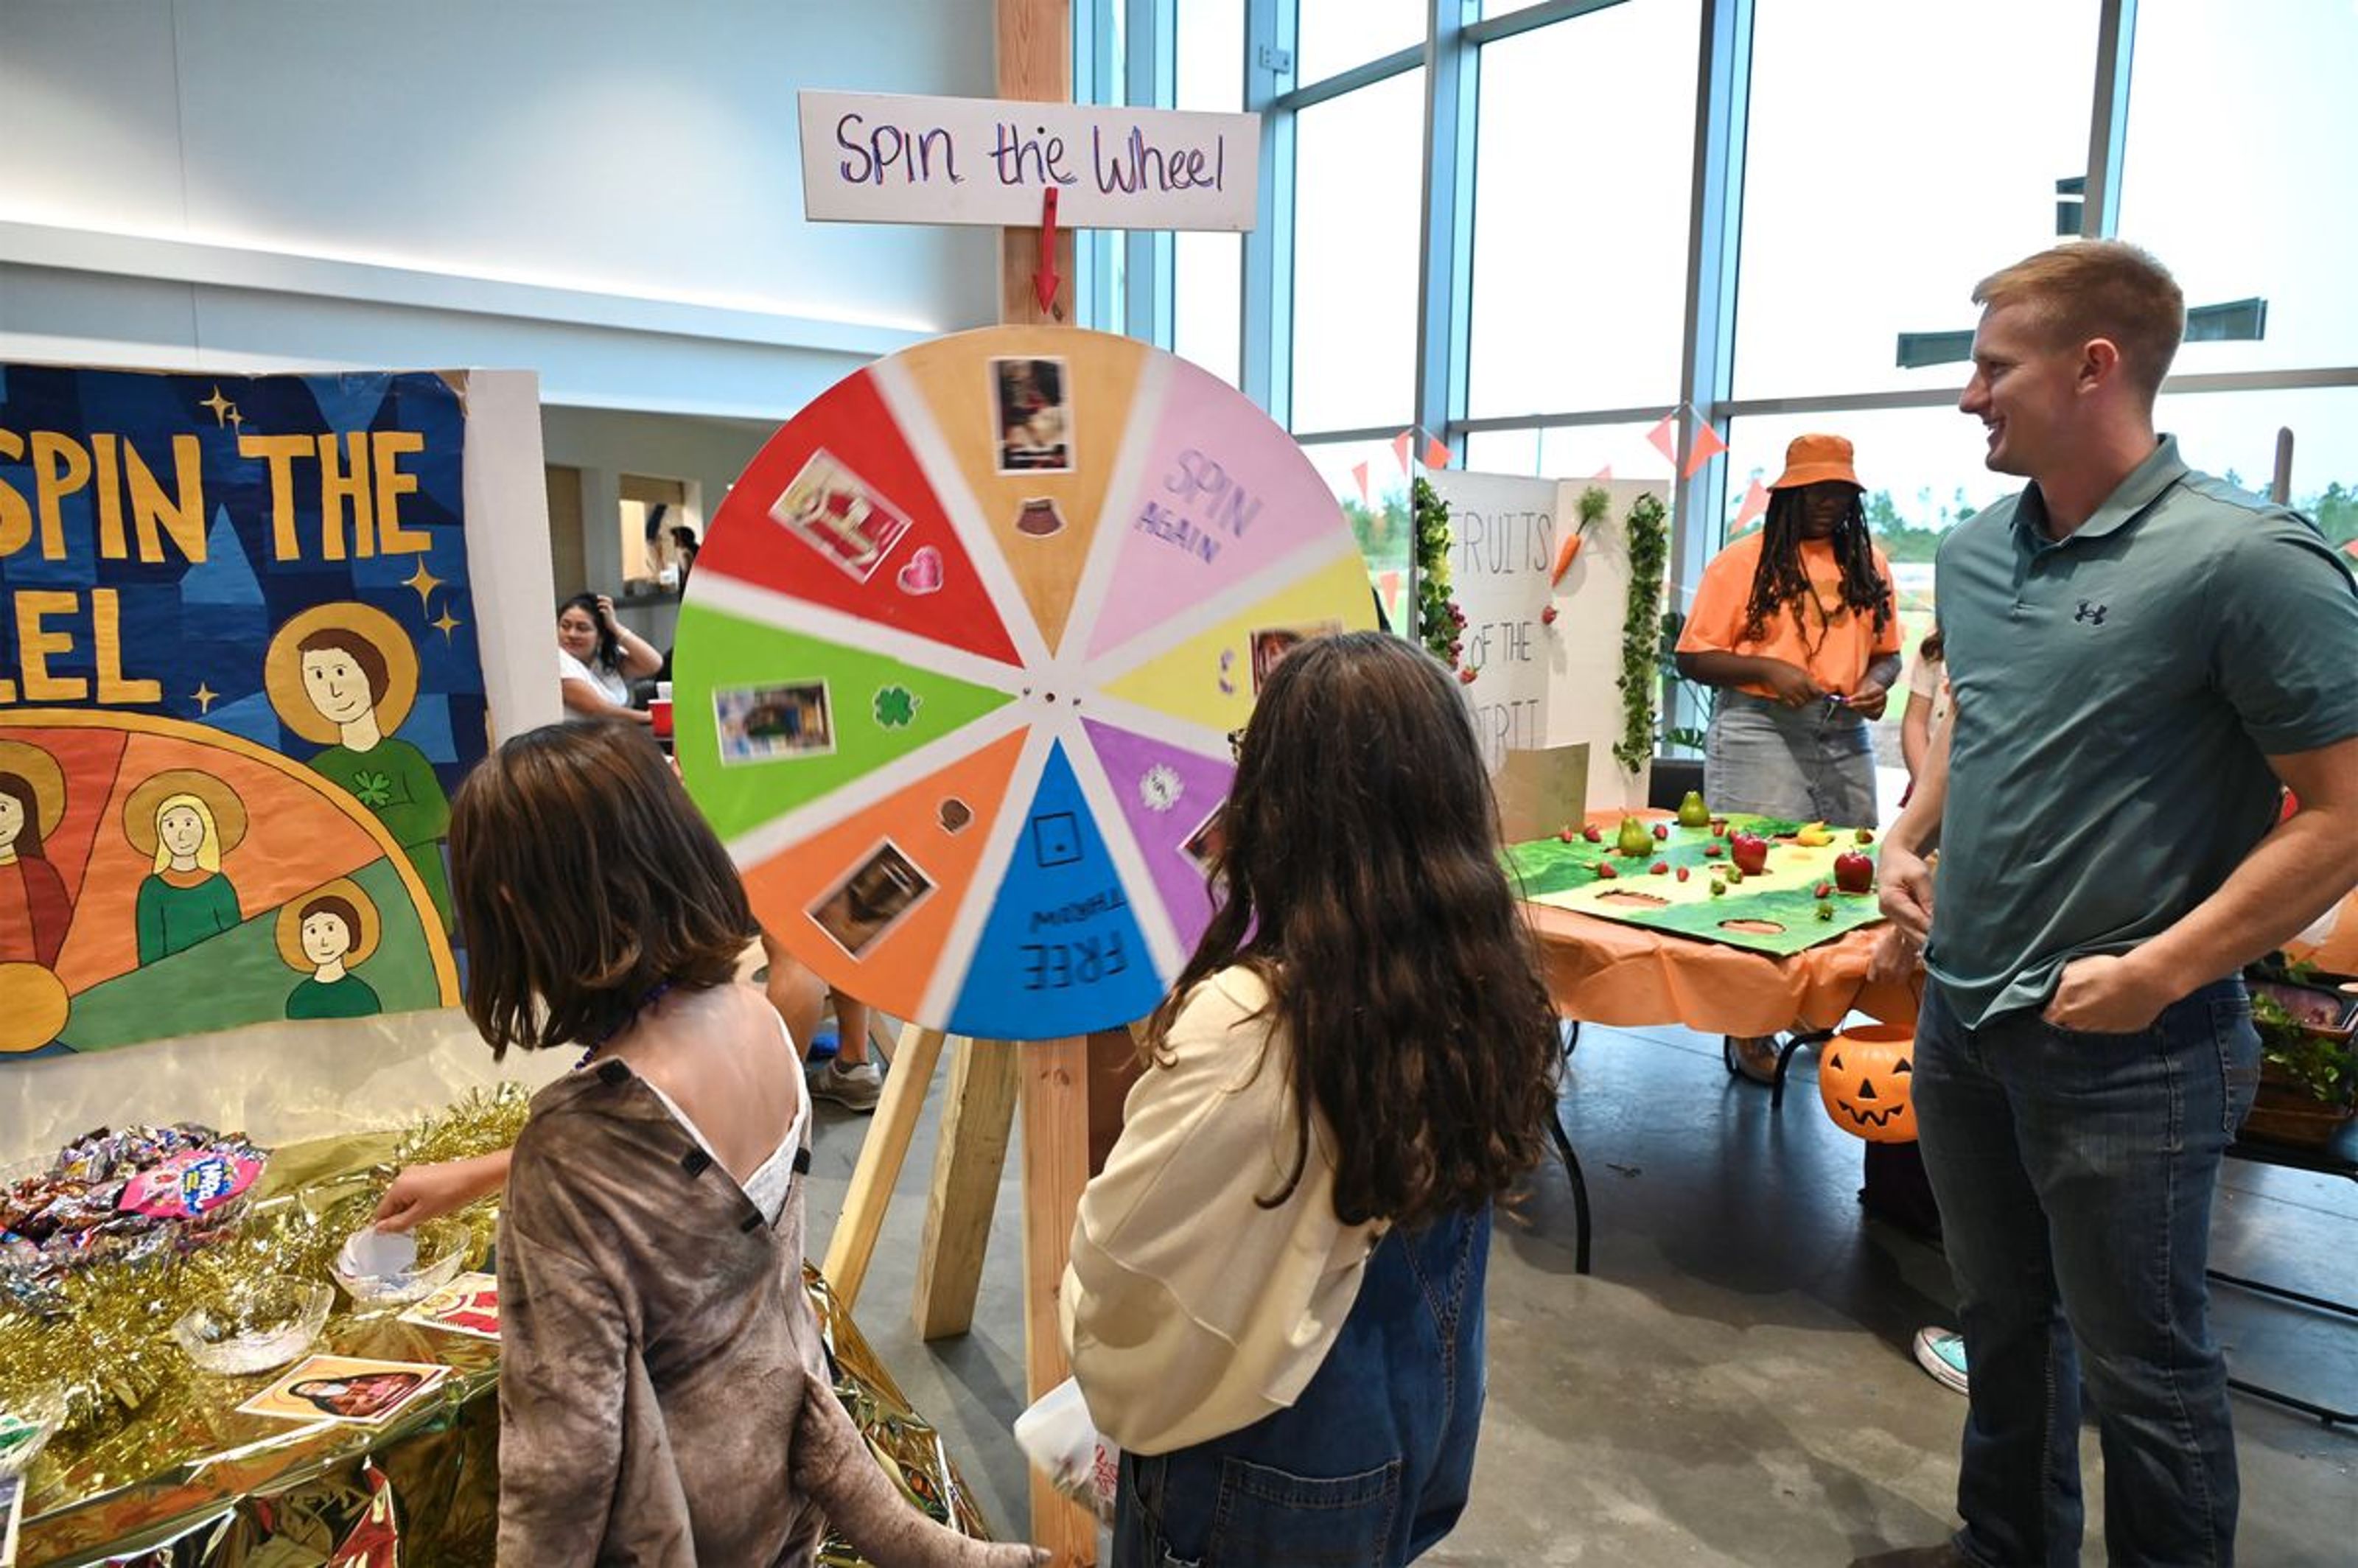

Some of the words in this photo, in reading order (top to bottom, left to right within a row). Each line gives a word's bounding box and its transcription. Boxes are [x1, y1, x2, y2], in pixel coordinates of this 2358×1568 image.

[836, 113, 962, 186] Spin
[988, 122, 1077, 186] the
[1093, 124, 1223, 194] Wheel
[0, 429, 207, 563] SPIN
[237, 431, 433, 561] THE
[1133, 500, 1221, 564] AGAIN
[1163, 448, 1263, 539] SPIN
[0, 588, 162, 704] EL
[1471, 624, 1494, 669] OF
[1501, 620, 1533, 662] THE
[1020, 931, 1127, 990] FREE
